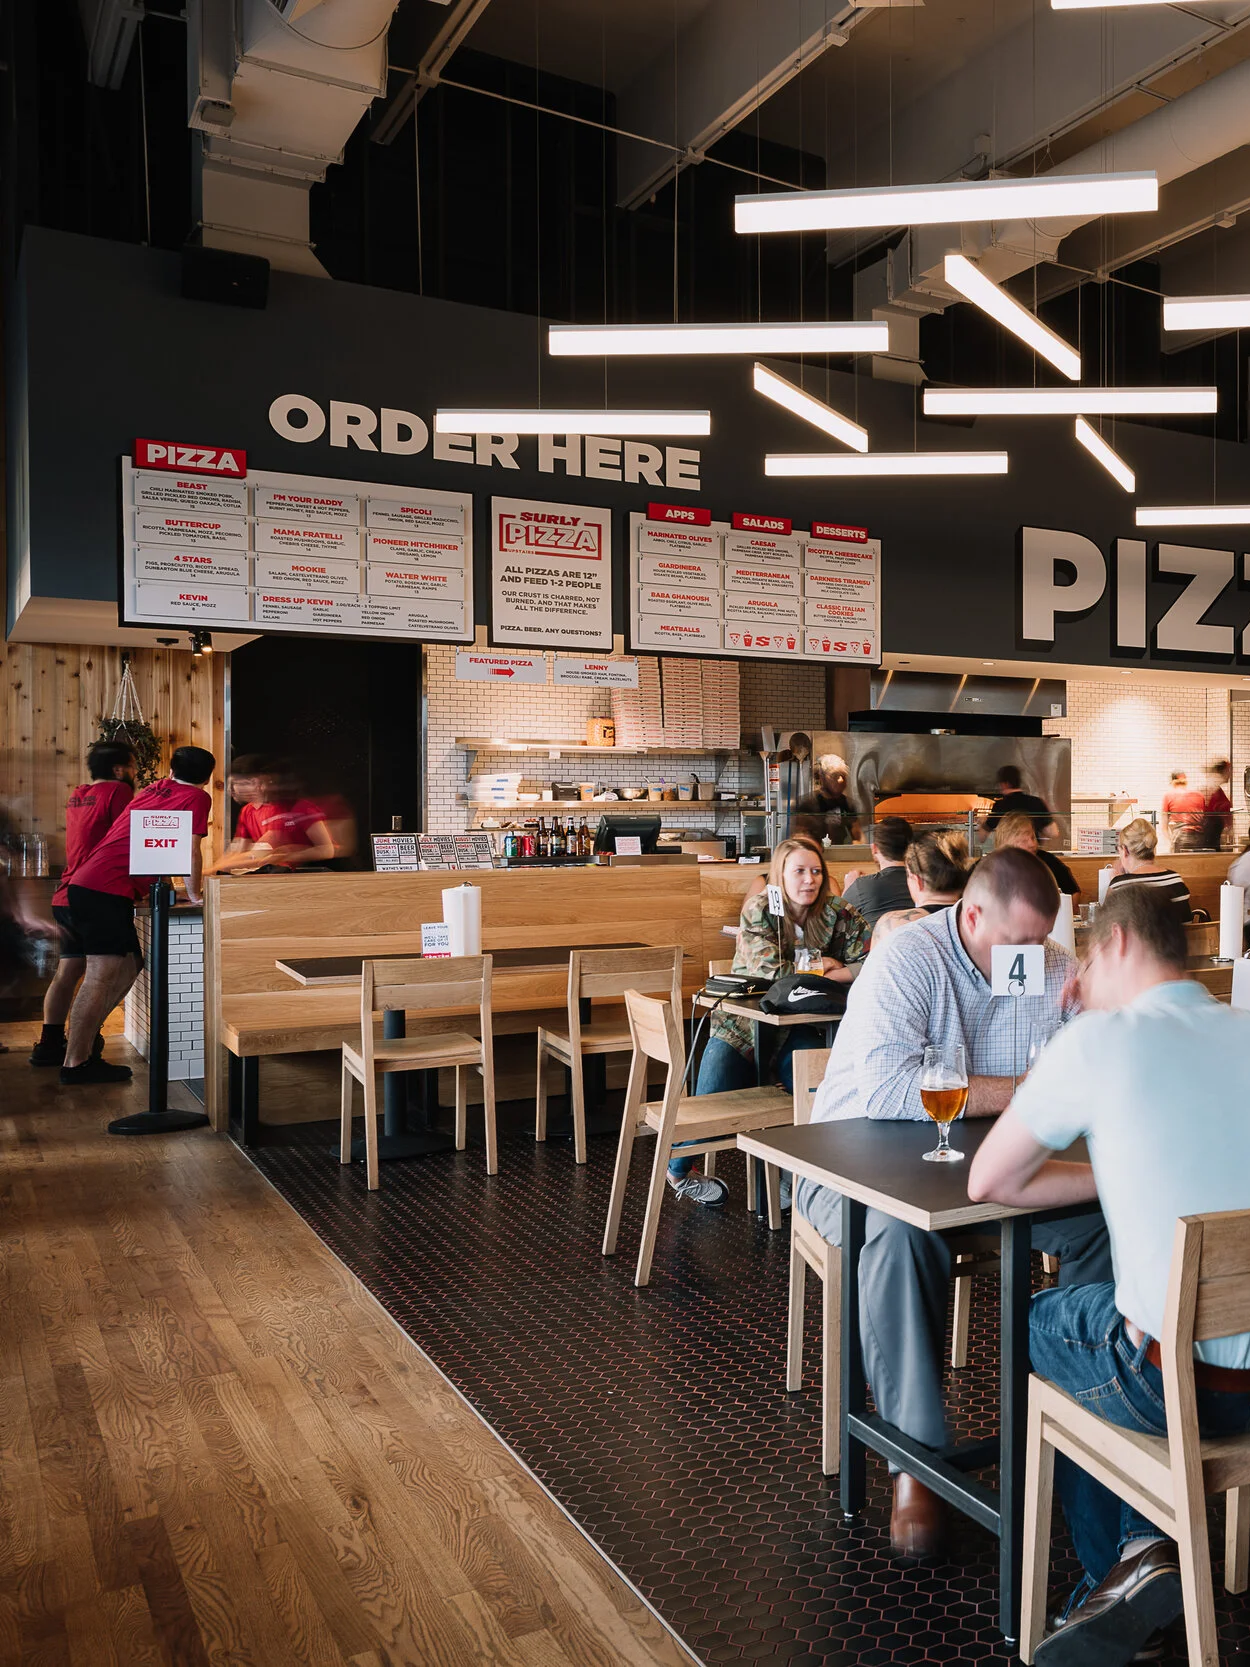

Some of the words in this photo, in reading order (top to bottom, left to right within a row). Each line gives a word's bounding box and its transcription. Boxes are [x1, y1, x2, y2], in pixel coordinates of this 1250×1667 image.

[268, 394, 520, 469] ORDER
[538, 433, 700, 491] HERE
[148, 444, 239, 472] PIZZA
[520, 512, 580, 526] SURLY
[666, 509, 694, 520] APPS
[165, 519, 221, 529] BUTTERCUP
[743, 518, 784, 530] SALADS
[303, 532, 342, 540] FRATELLI
[506, 523, 596, 552] PIZZA
[648, 531, 687, 539] MARINATED
[816, 526, 866, 539] DESSERTS
[373, 538, 408, 546] PIONEER
[411, 542, 458, 550] HITCHHIKER
[526, 568, 559, 576] PIZZAS
[659, 563, 701, 571] GIARDINIERA
[736, 570, 790, 579] MEDITERRANEAN
[524, 577, 548, 585] FEED
[566, 581, 601, 589] PEOPLE
[145, 839, 178, 848] EXIT
[770, 890, 780, 911] 19
[1009, 954, 1026, 986] 4
